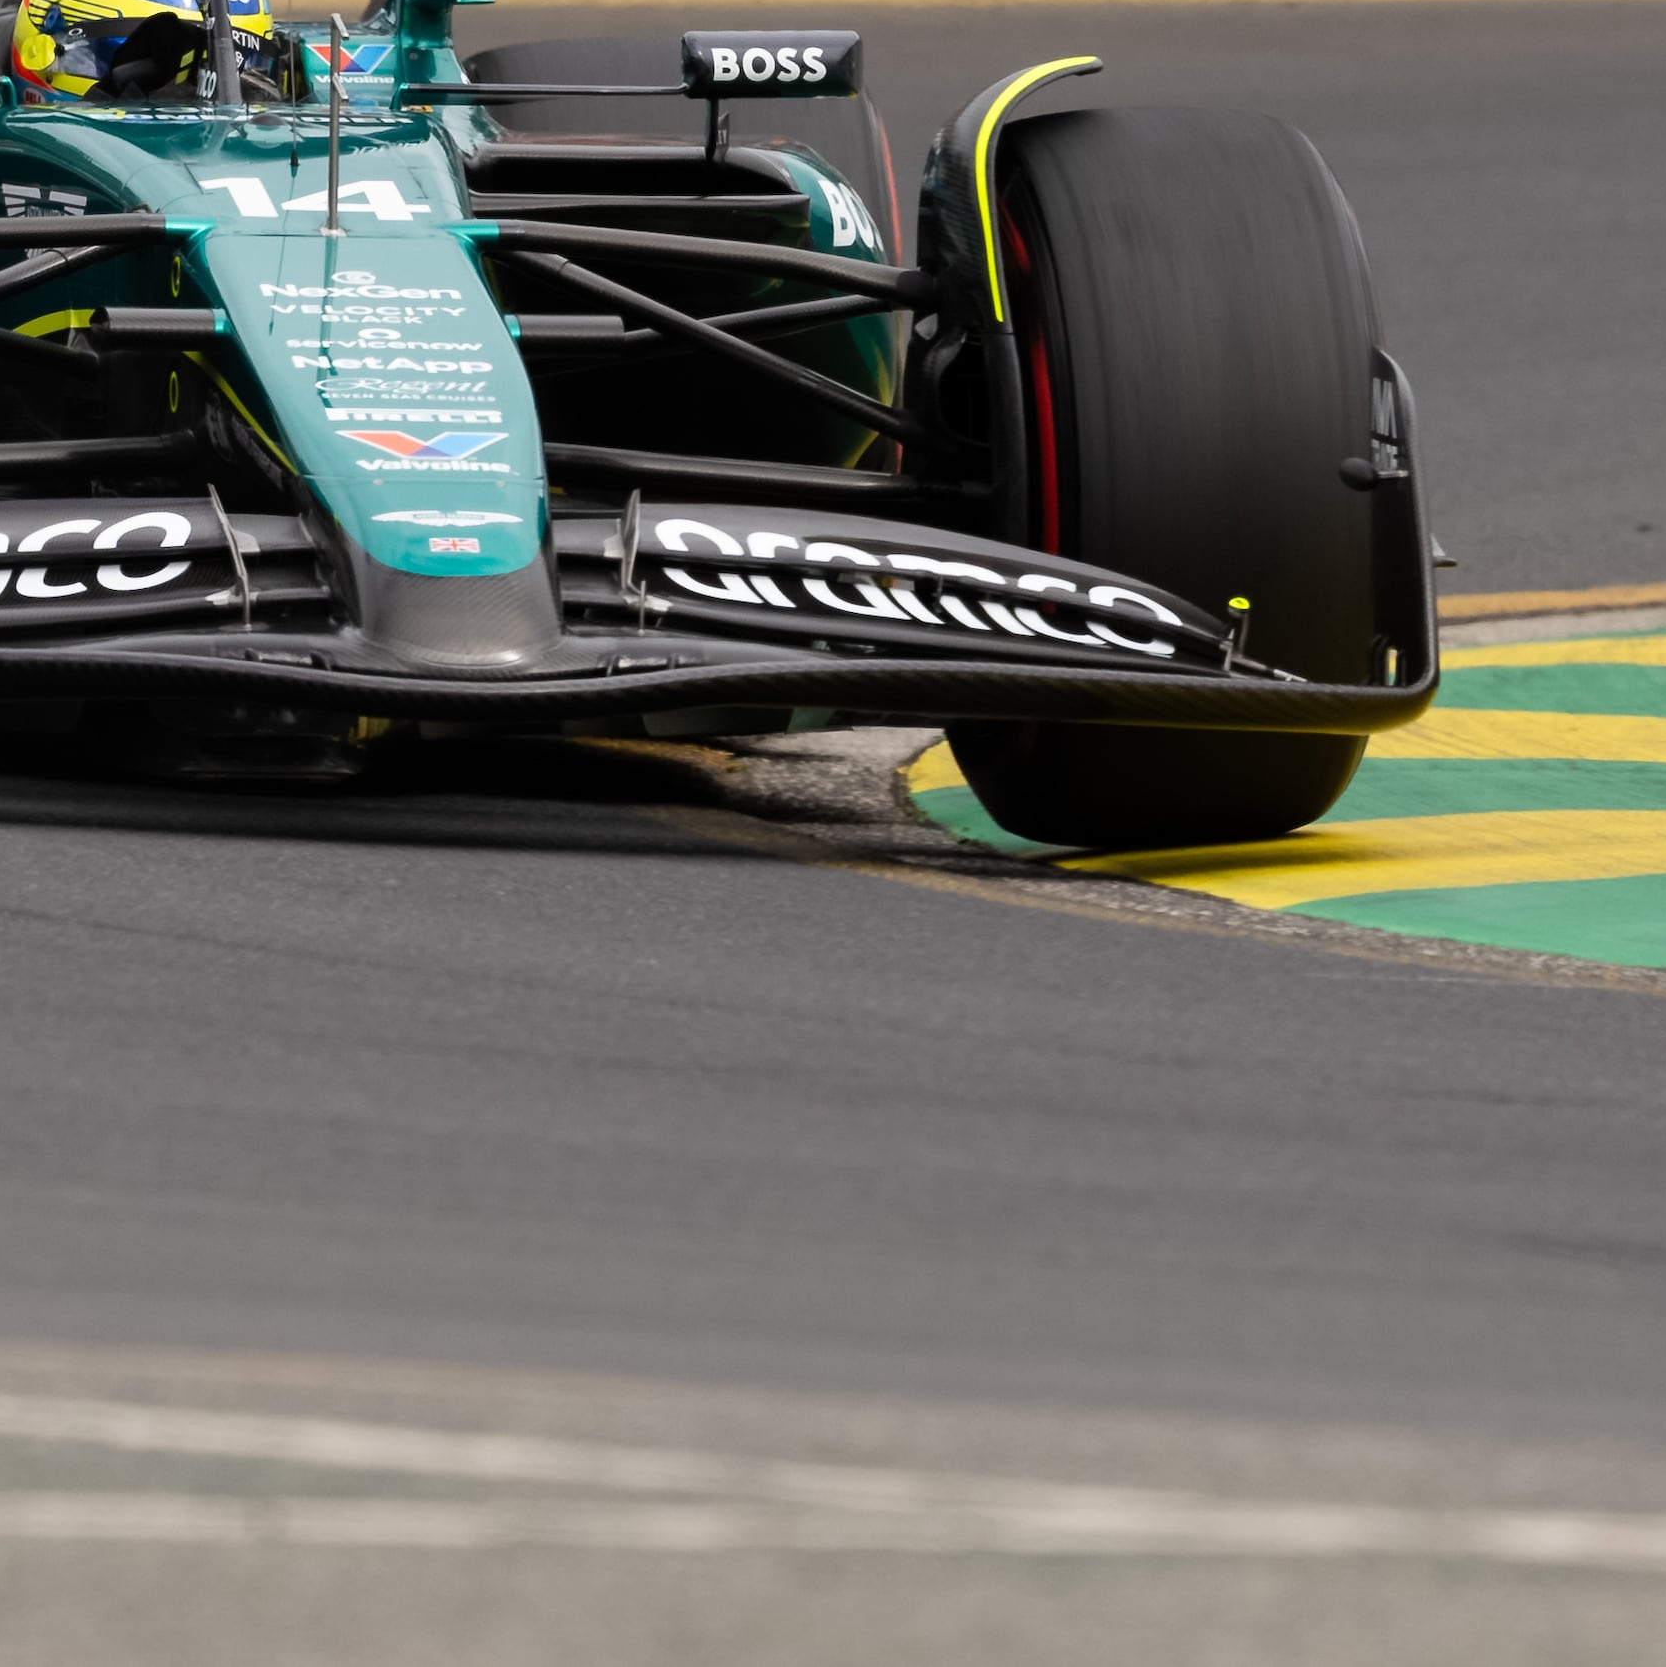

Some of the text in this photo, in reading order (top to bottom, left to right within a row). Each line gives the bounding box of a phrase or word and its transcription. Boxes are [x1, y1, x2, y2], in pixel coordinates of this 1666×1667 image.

[231, 29, 260, 51] RTIN
[711, 47, 827, 82] BOSS
[314, 74, 395, 84] Vlvoline
[197, 177, 432, 221] 14
[259, 283, 463, 301] NexGen
[270, 304, 467, 317] VELOCITY
[321, 314, 423, 325] BLACK
[285, 338, 484, 351] servicenow
[291, 355, 494, 374] NetApp
[314, 377, 487, 393] Regent
[382, 393, 421, 401] SEAS
[426, 394, 497, 403] CRUISES
[325, 407, 503, 424] PIRELLI
[355, 458, 513, 474] Valvoline
[654, 517, 1182, 657] aramco
